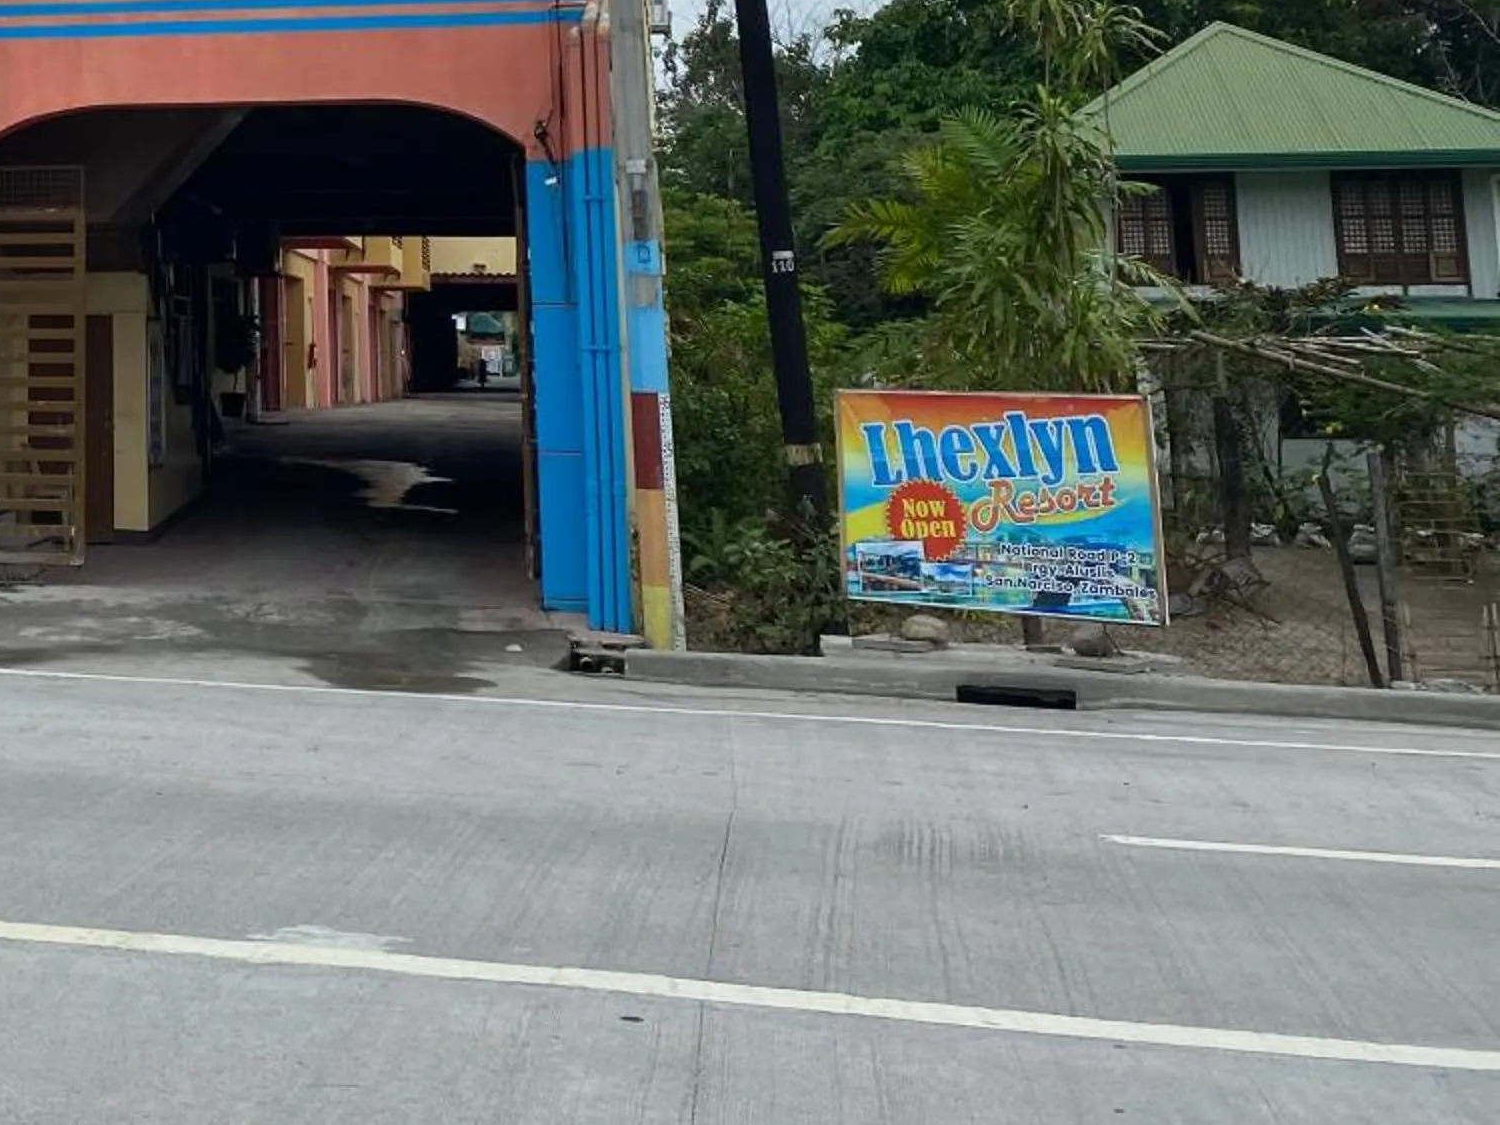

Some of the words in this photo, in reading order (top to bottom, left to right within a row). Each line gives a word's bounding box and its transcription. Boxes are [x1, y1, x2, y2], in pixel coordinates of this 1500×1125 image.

[861, 411, 1119, 488] Lhexlyn
[903, 499, 946, 519] Now
[970, 476, 1116, 534] Resort
[901, 516, 957, 540] Open
[1001, 544, 1063, 559] National
